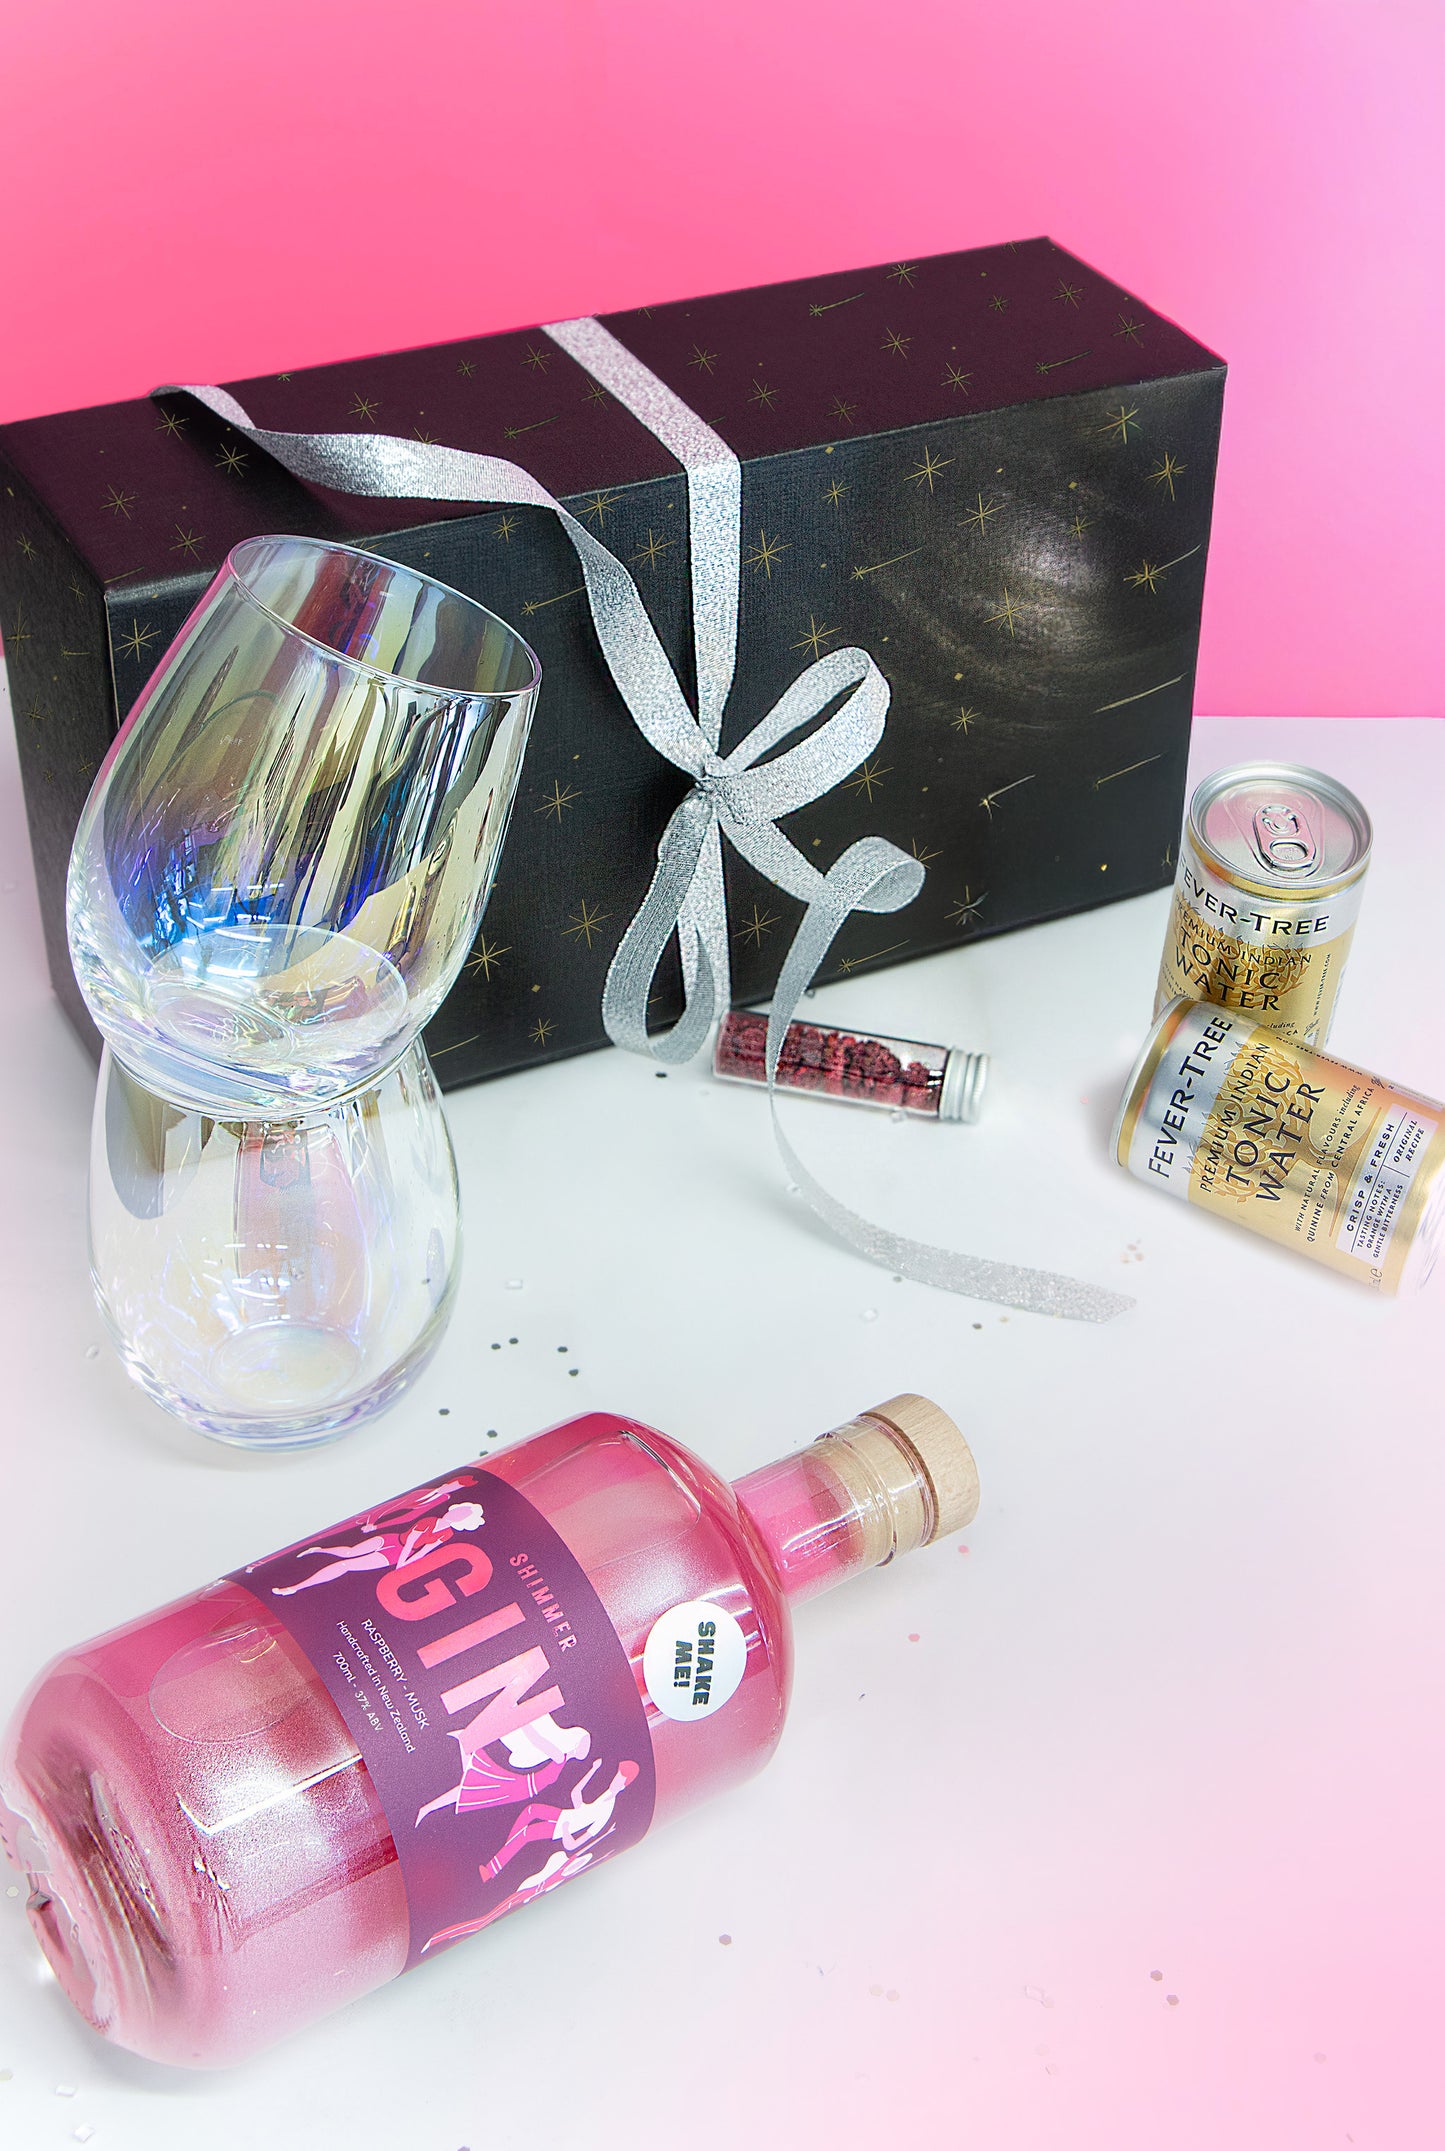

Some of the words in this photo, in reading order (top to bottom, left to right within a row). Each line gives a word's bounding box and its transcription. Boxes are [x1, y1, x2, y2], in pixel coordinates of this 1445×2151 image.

[1180, 852, 1330, 936] FEVER-TREE
[1176, 945, 1281, 1011] WATER
[1180, 926, 1280, 989] TONIC
[1241, 951, 1312, 967] INDIAN
[1148, 1016, 1233, 1179] FEVER-TREE
[1200, 1108, 1237, 1193] PREMIUM
[1230, 1042, 1271, 1102] INDIAN
[1225, 1071, 1291, 1186] TONIC
[1255, 1083, 1326, 1201] WATER
[1295, 1212, 1305, 1232] WITH
[1300, 1168, 1321, 1211] NATURAL
[1316, 1116, 1342, 1165] FLAVOURS
[1337, 1084, 1361, 1116] including
[1306, 1201, 1325, 1243] QUININE
[1320, 1171, 1335, 1200] FROM
[1331, 1119, 1358, 1168] CENTRAL
[1354, 1087, 1375, 1116] AFRICA
[1346, 1190, 1366, 1232] CRISP
[1364, 1174, 1373, 1184] &
[1370, 1123, 1395, 1168] FRESH
[1393, 1119, 1418, 1163] ORIGINAL
[1405, 1127, 1425, 1162] RECIPE
[1357, 1215, 1373, 1248] TASTING
[1369, 1180, 1386, 1213] NOTES:
[1366, 1218, 1381, 1249] ORANGE
[1376, 1195, 1389, 1217] WITH
[1386, 1187, 1392, 1195] A
[1373, 1233, 1386, 1258] GENTLE
[1381, 1184, 1404, 1232] BITTERNESS
[509, 1552, 578, 1652] SHIMMER
[332, 1651, 357, 1684] 700ml
[354, 1690, 371, 1711] 37%
[366, 1711, 384, 1732] ABV
[336, 1620, 378, 1677] Handcrafted
[371, 1675, 381, 1687] in
[377, 1685, 394, 1710] New
[389, 1708, 416, 1754] Zealand
[361, 1618, 408, 1683] RASPBERRY
[404, 1691, 430, 1730] MUSK
[376, 1542, 566, 1756] GIN
[673, 1640, 693, 1688] ME!
[692, 1621, 717, 1706] SHAKE
